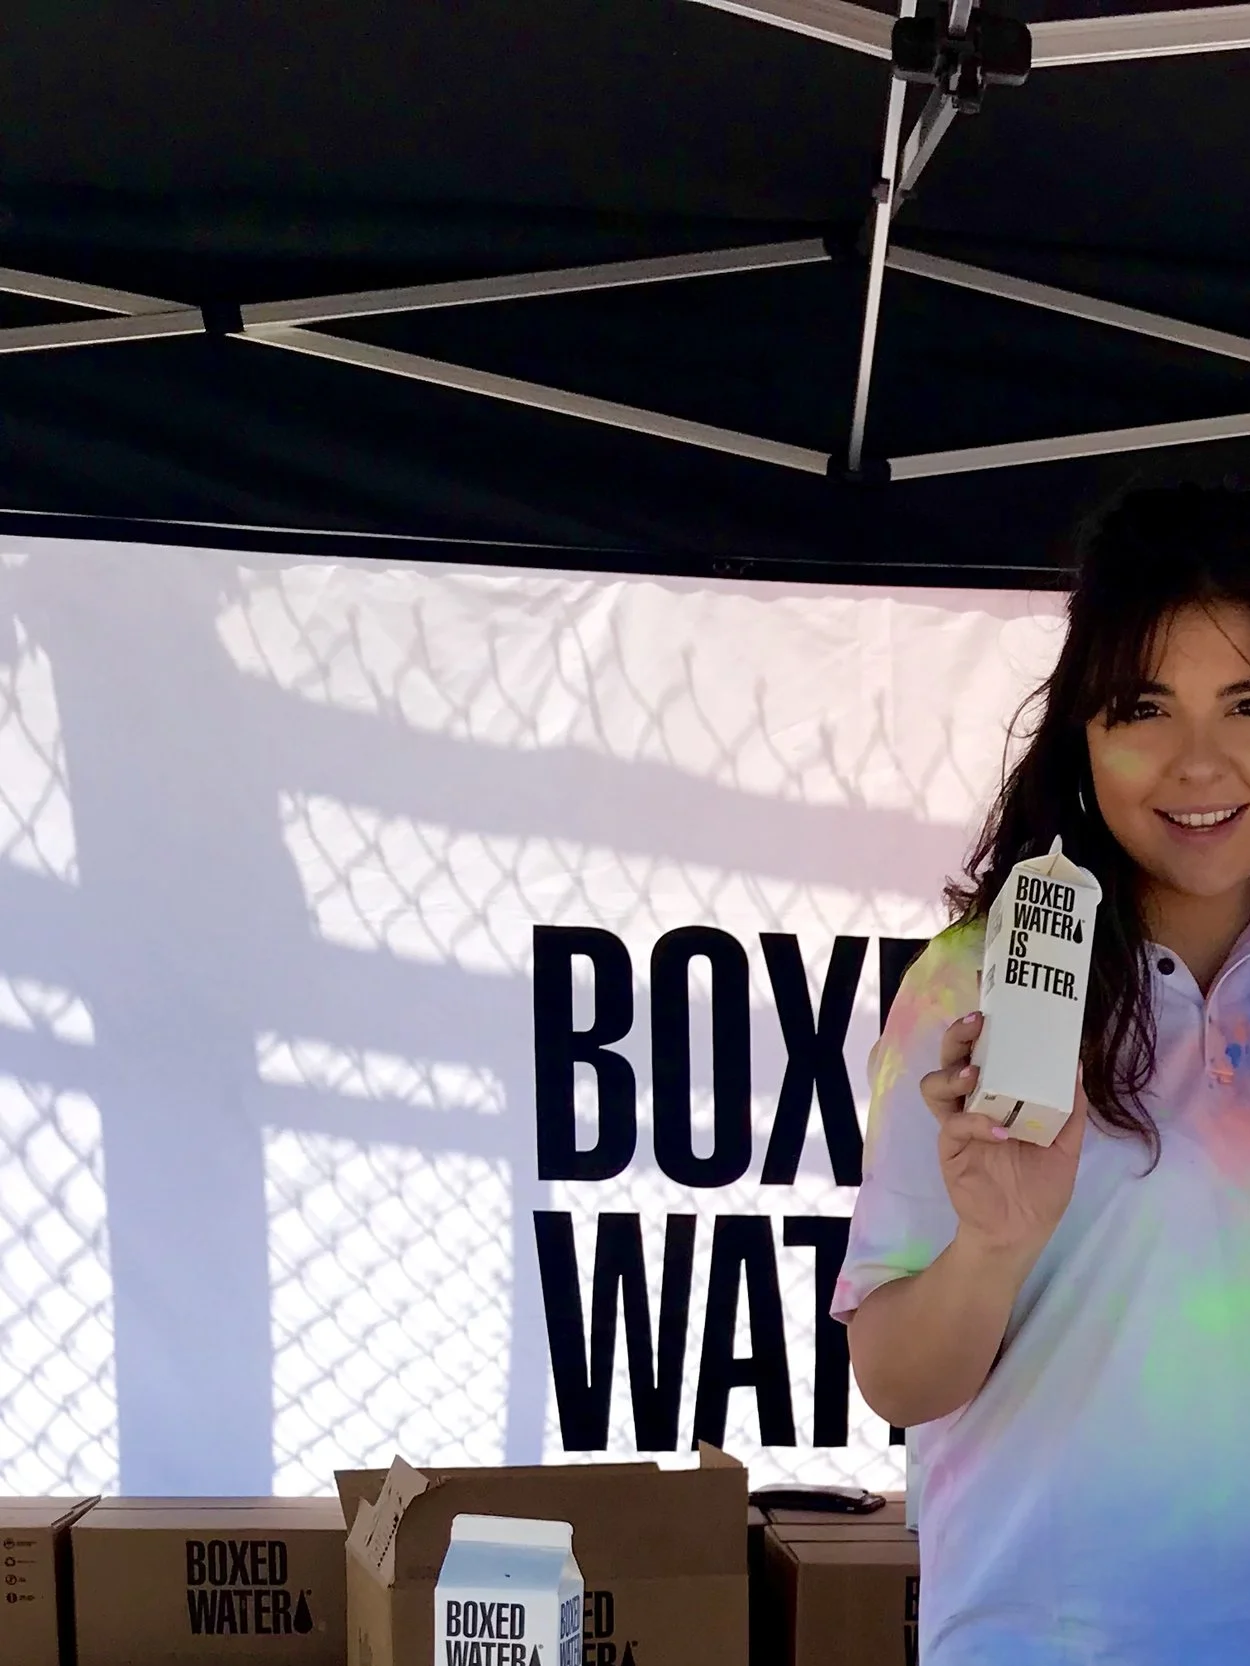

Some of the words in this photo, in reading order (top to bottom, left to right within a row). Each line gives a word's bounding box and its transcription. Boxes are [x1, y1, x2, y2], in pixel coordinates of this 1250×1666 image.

[1015, 875, 1076, 913] BOXED
[1008, 929, 1029, 958] IS
[1012, 902, 1073, 942] WATER
[1004, 957, 1079, 1001] BETTER.
[532, 924, 930, 1188] BOX
[532, 1210, 906, 1452] WAT
[186, 1540, 288, 1586] BOXED
[186, 1589, 293, 1635] WATER
[446, 1600, 526, 1640] BOXED
